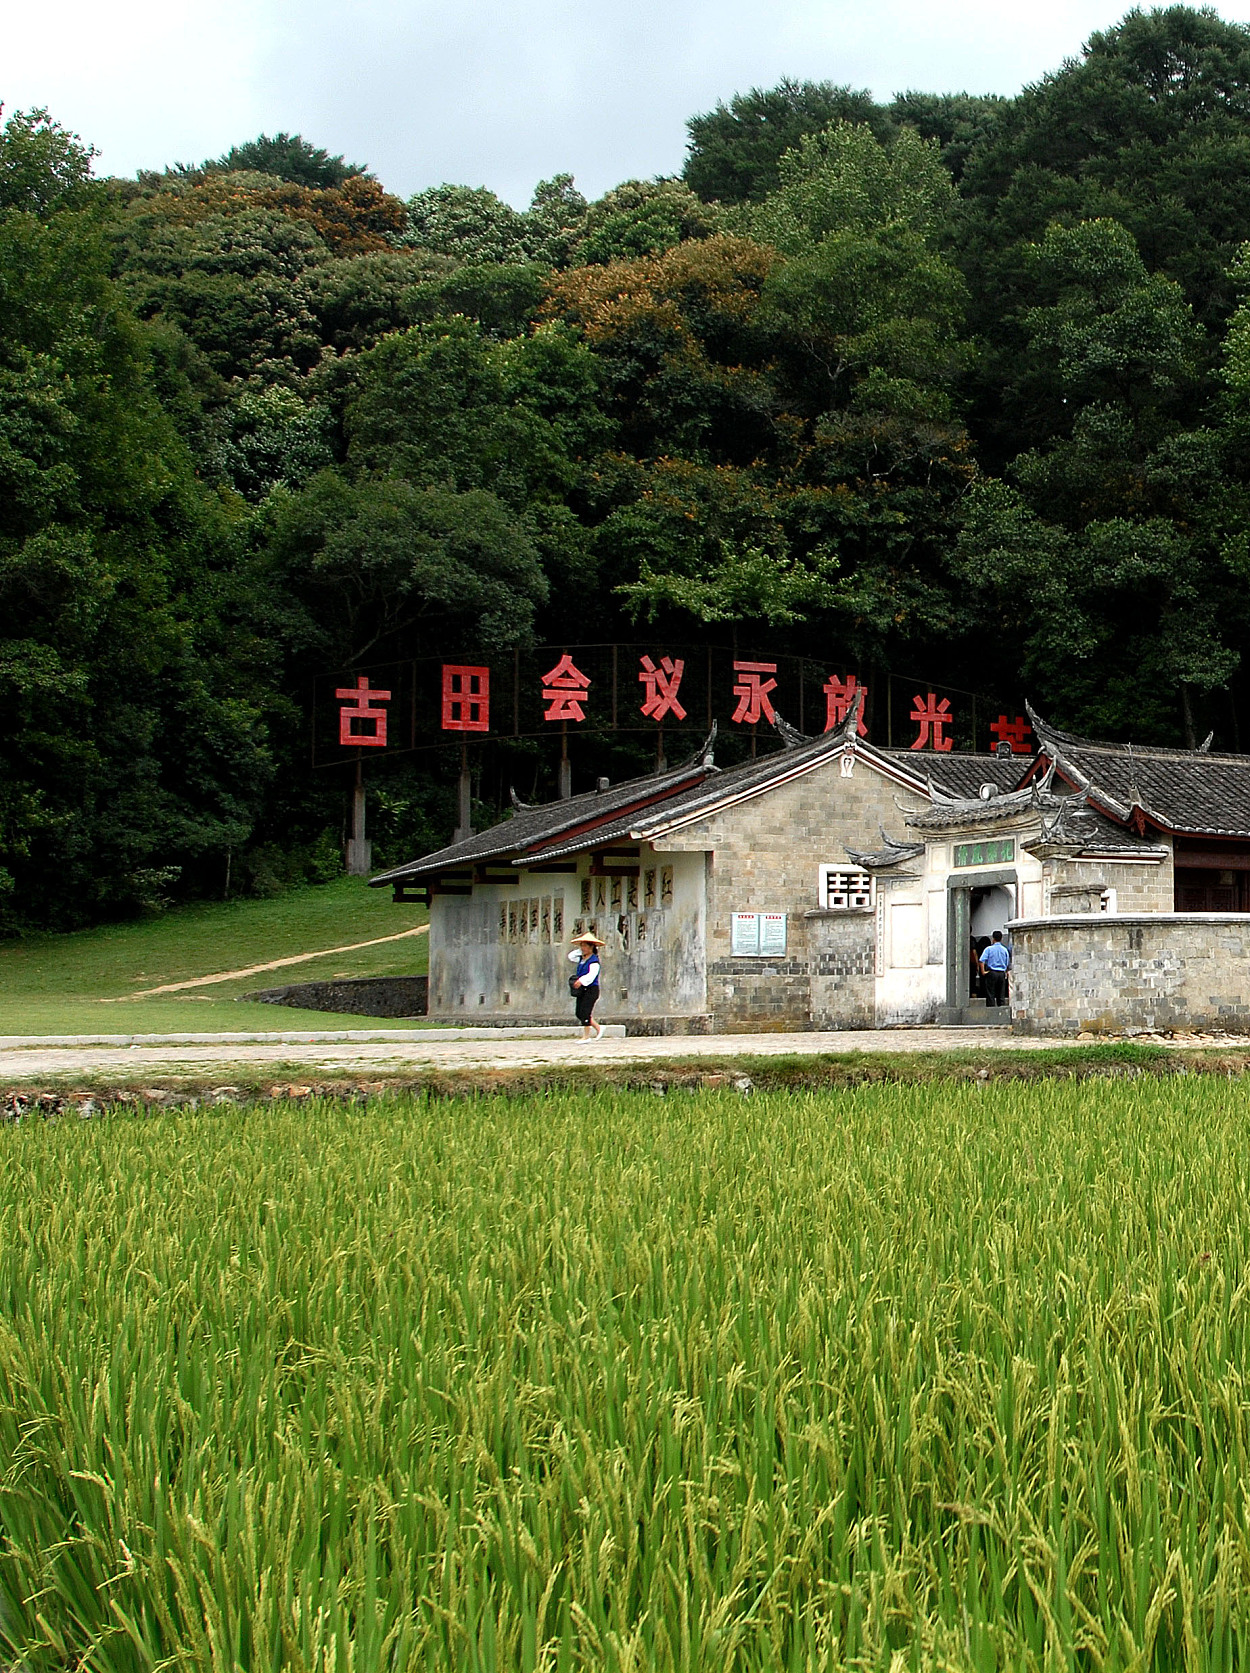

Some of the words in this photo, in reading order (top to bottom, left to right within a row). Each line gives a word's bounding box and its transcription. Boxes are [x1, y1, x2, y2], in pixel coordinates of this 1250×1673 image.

[336, 654, 1031, 753] 古田会议永放光芒
